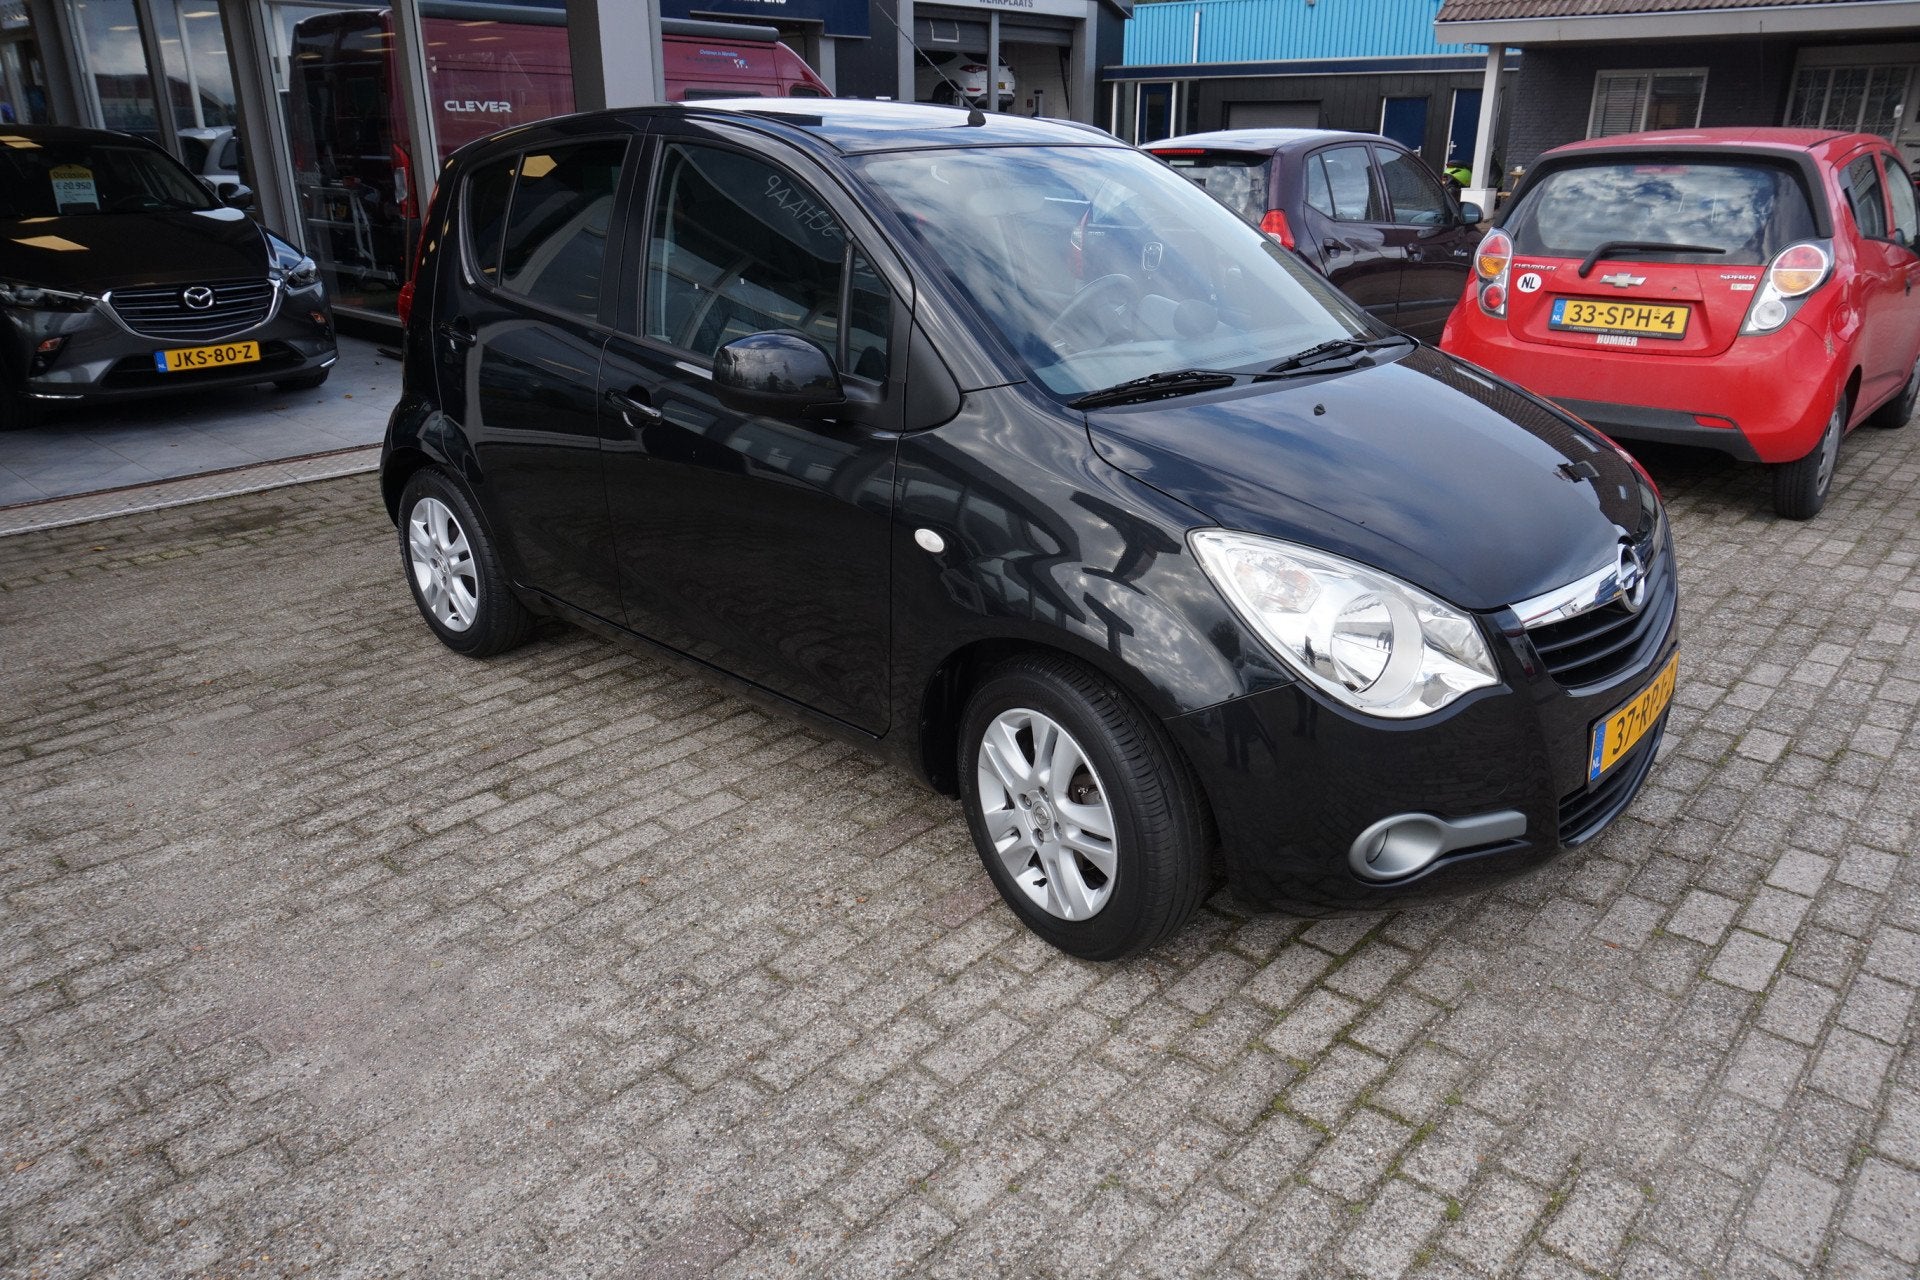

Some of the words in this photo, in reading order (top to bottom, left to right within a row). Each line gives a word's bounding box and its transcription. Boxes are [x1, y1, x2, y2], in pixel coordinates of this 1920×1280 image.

[444, 100, 512, 113] CLEVER
[1513, 263, 1557, 271] CHEVROLET
[1521, 276, 1535, 289] NL
[1569, 304, 1675, 329] 33-SPH-4
[1596, 334, 1638, 346] HUMMER
[174, 345, 253, 368] JKS-80-Z
